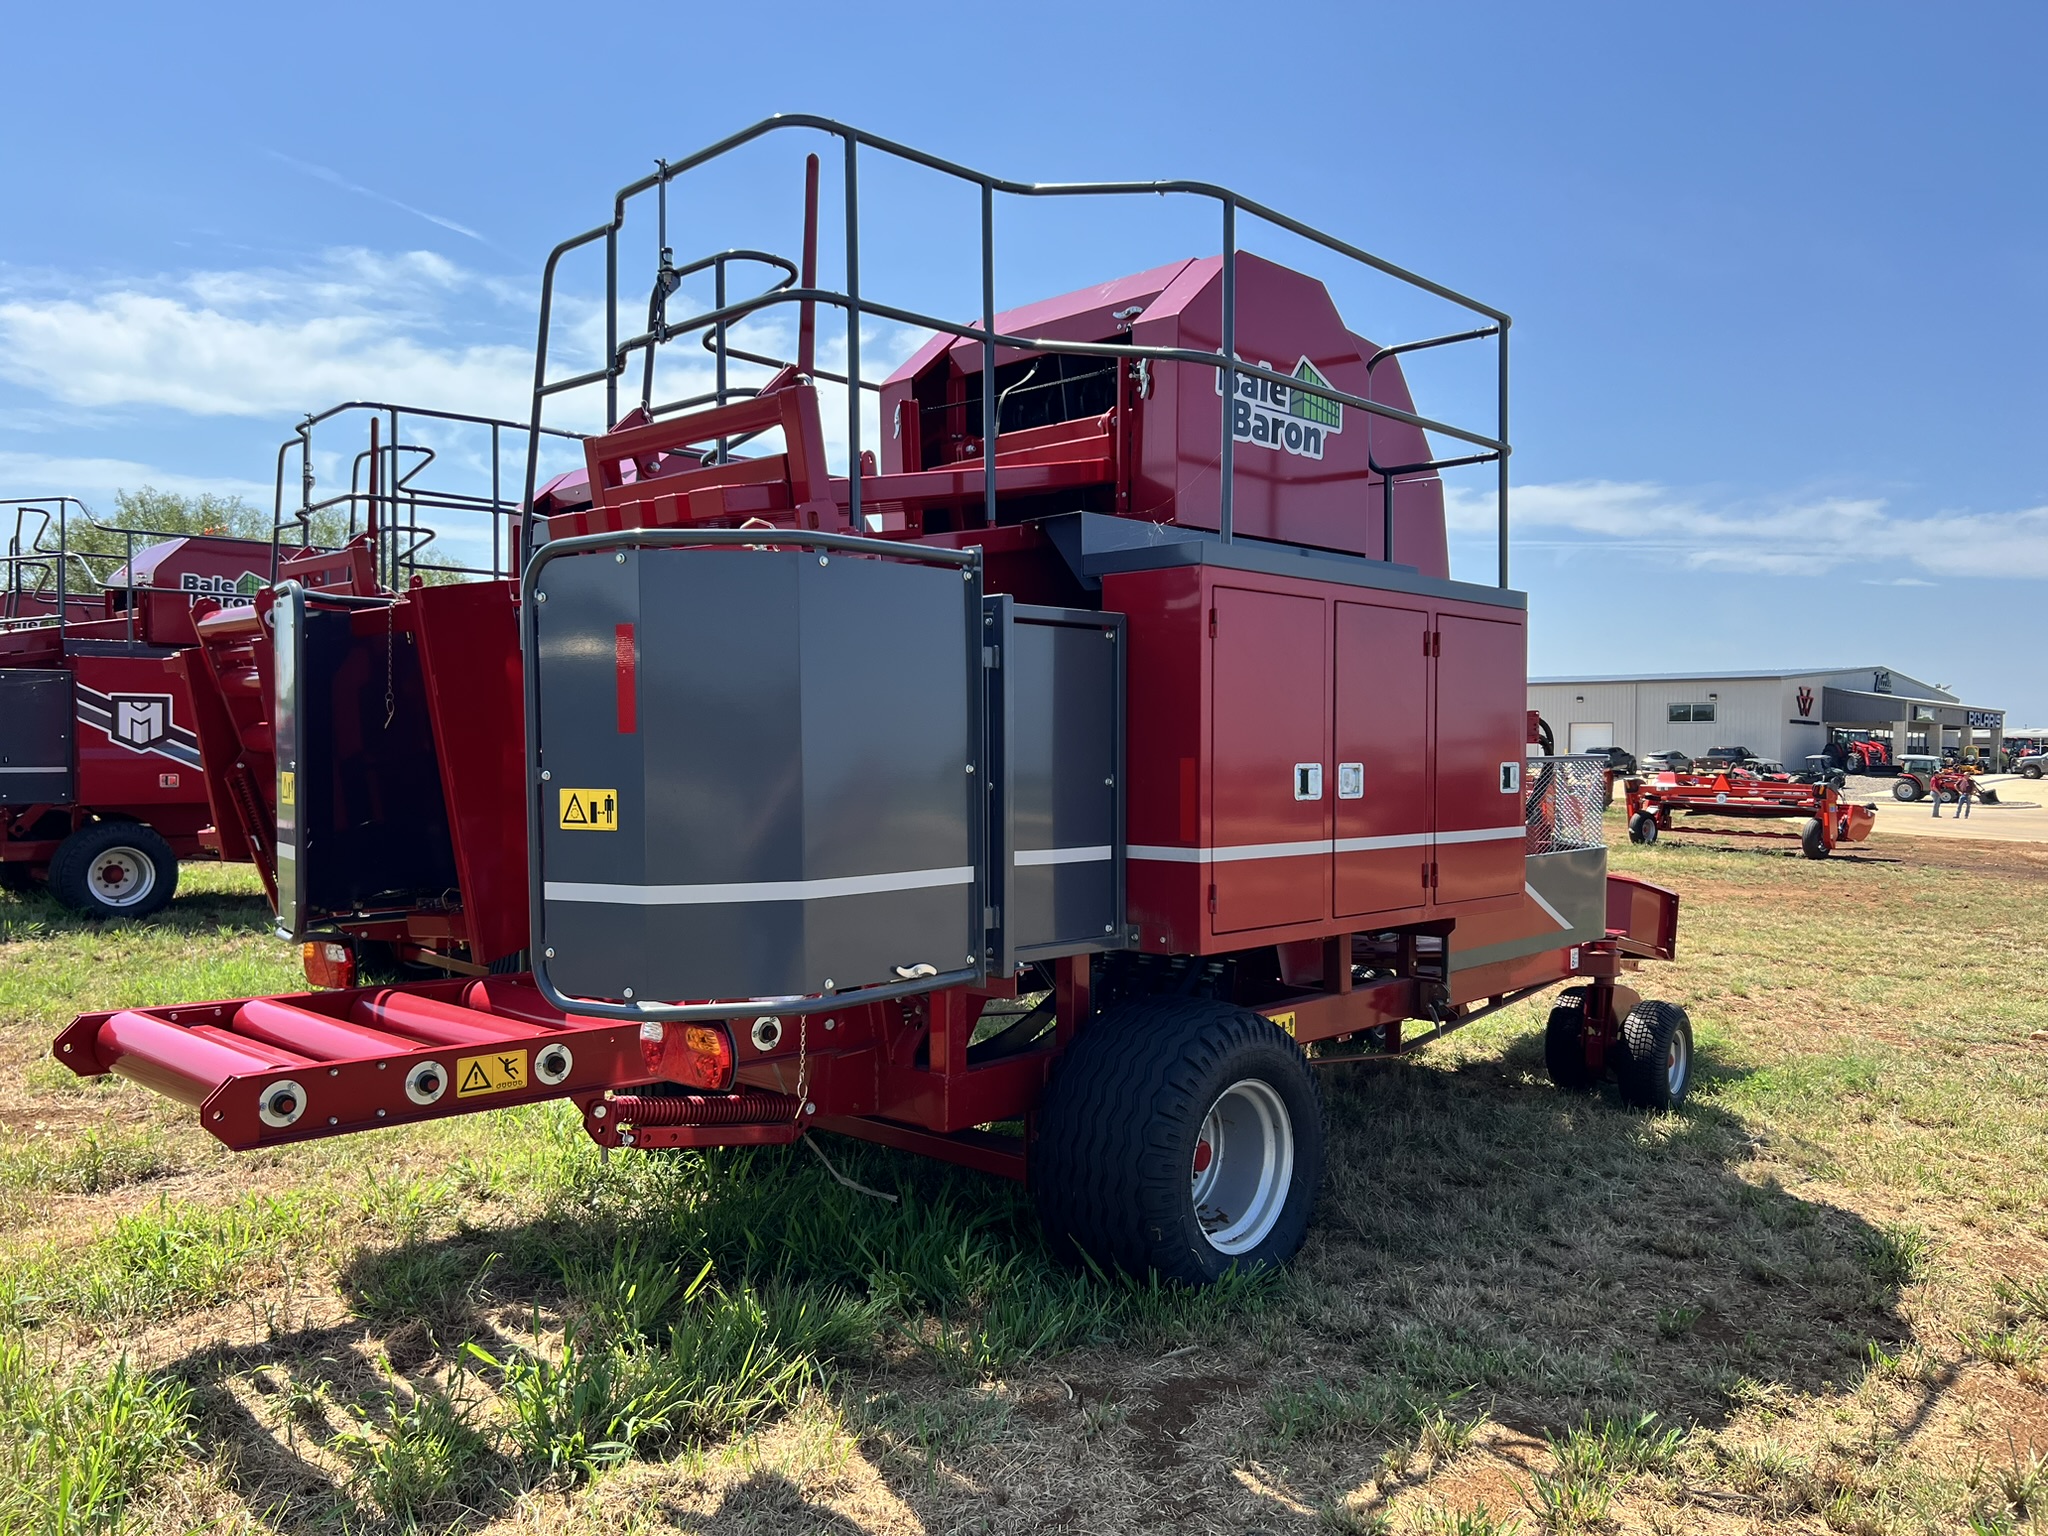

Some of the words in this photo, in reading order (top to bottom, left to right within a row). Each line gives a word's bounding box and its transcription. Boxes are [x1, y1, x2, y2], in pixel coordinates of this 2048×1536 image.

[1233, 398, 1321, 455] Baron
[183, 575, 235, 593] Bale
[1968, 711, 2001, 728] POLARIS
